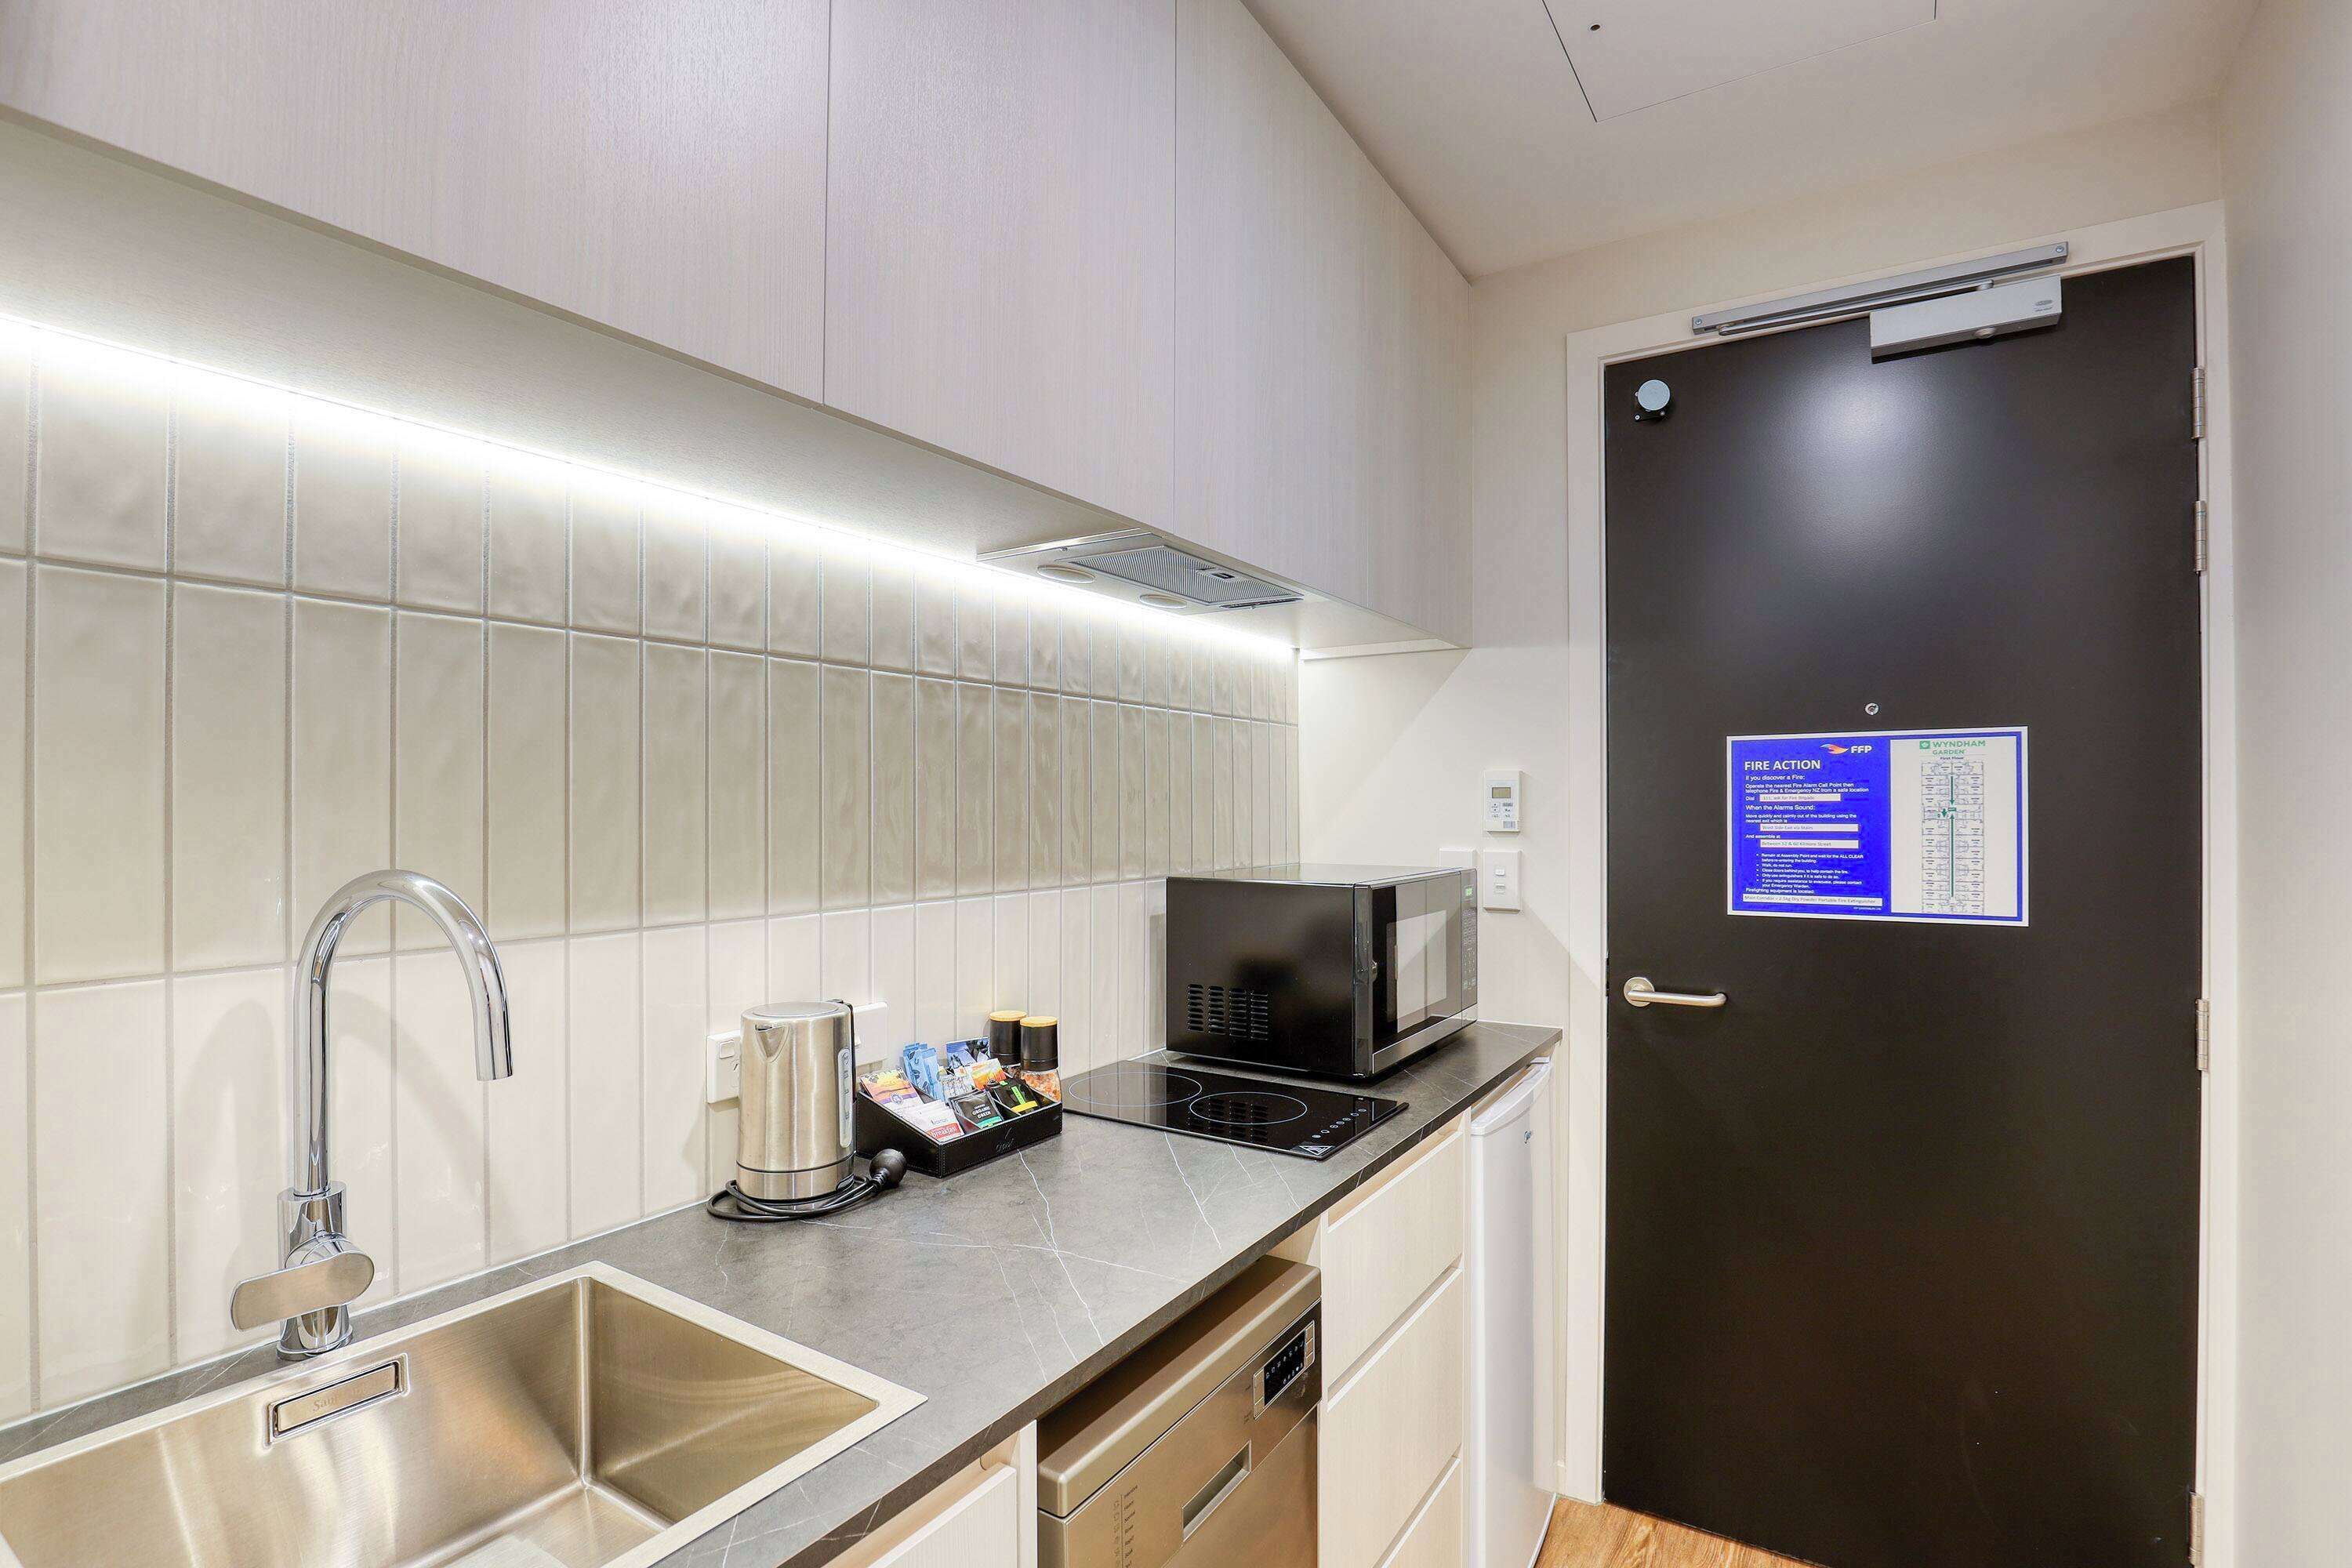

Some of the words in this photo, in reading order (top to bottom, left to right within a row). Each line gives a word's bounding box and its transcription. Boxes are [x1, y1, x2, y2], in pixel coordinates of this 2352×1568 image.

[1744, 761, 1770, 770] FIRE
[1773, 760, 1820, 770] ACTION
[972, 1106, 991, 1115] ORGANIC
